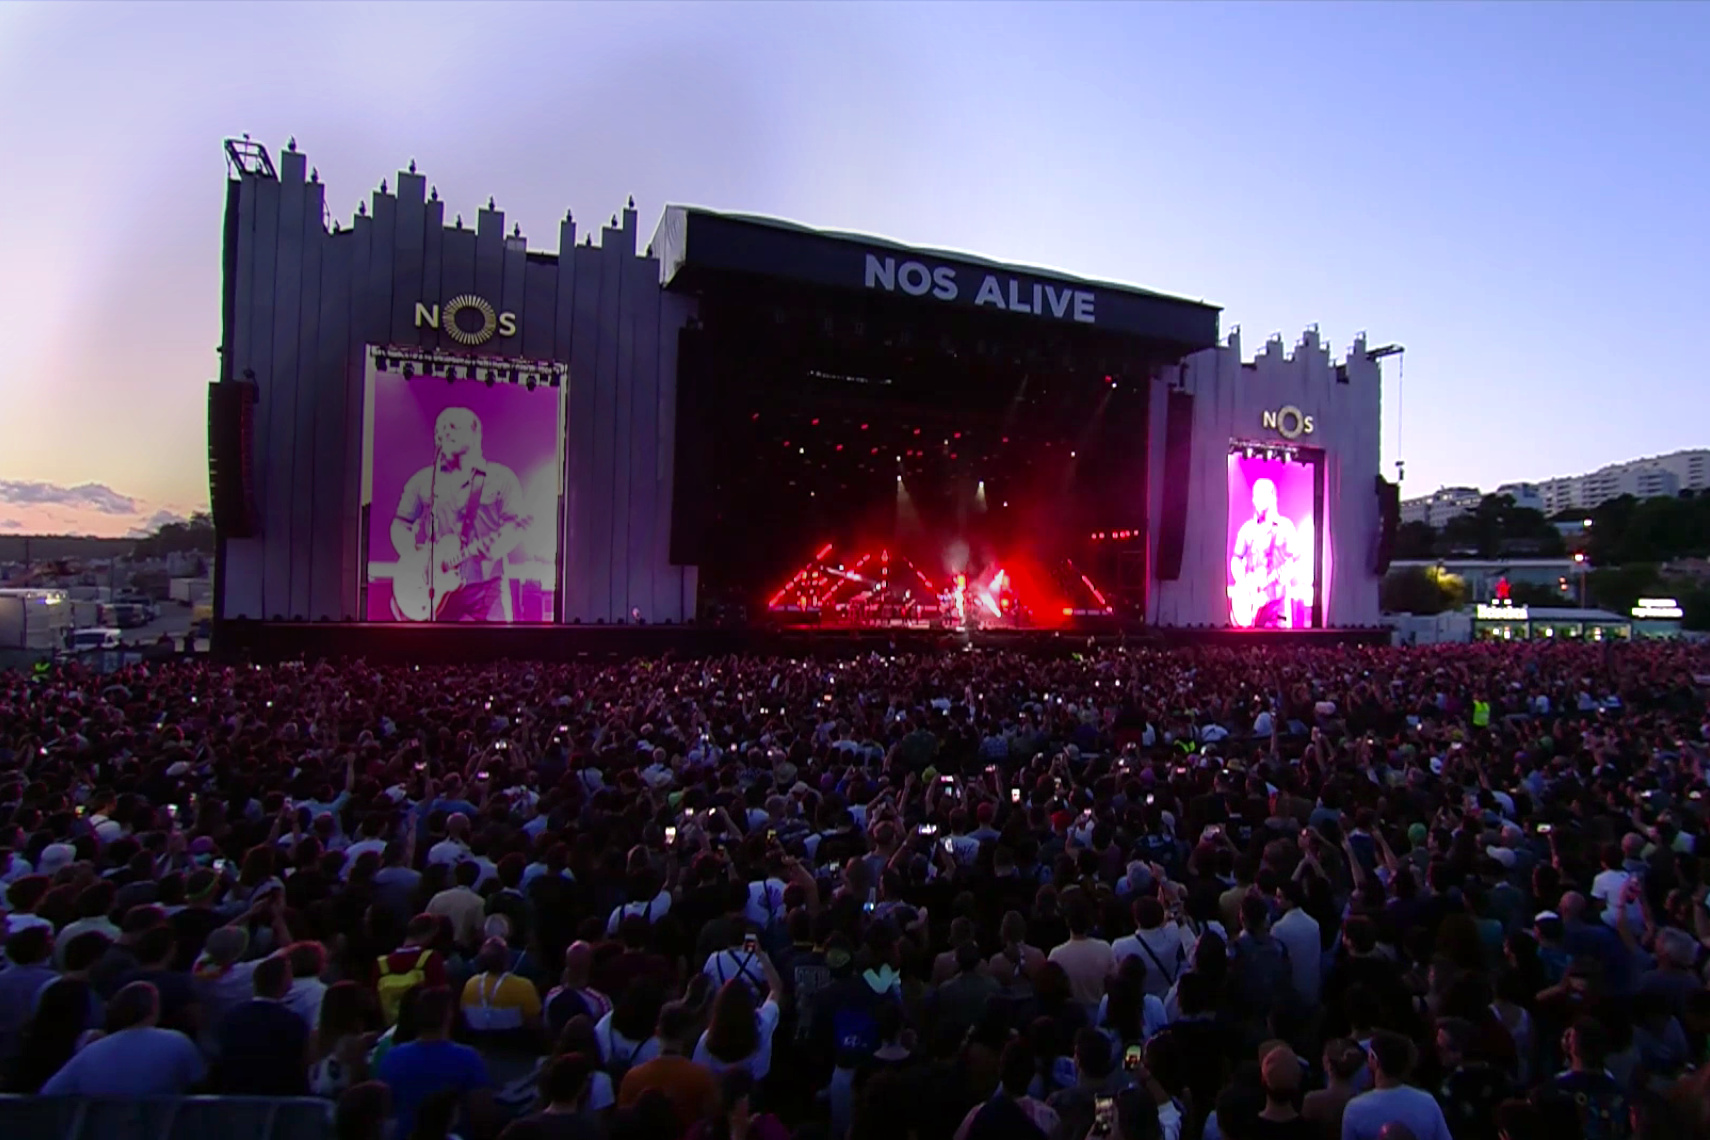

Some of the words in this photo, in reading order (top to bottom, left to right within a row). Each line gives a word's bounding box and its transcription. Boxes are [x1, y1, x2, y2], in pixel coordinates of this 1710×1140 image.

[865, 254, 958, 300] NOS
[975, 275, 1095, 323] ALIVE
[415, 295, 517, 345] NOS
[1264, 406, 1314, 438] NOS
